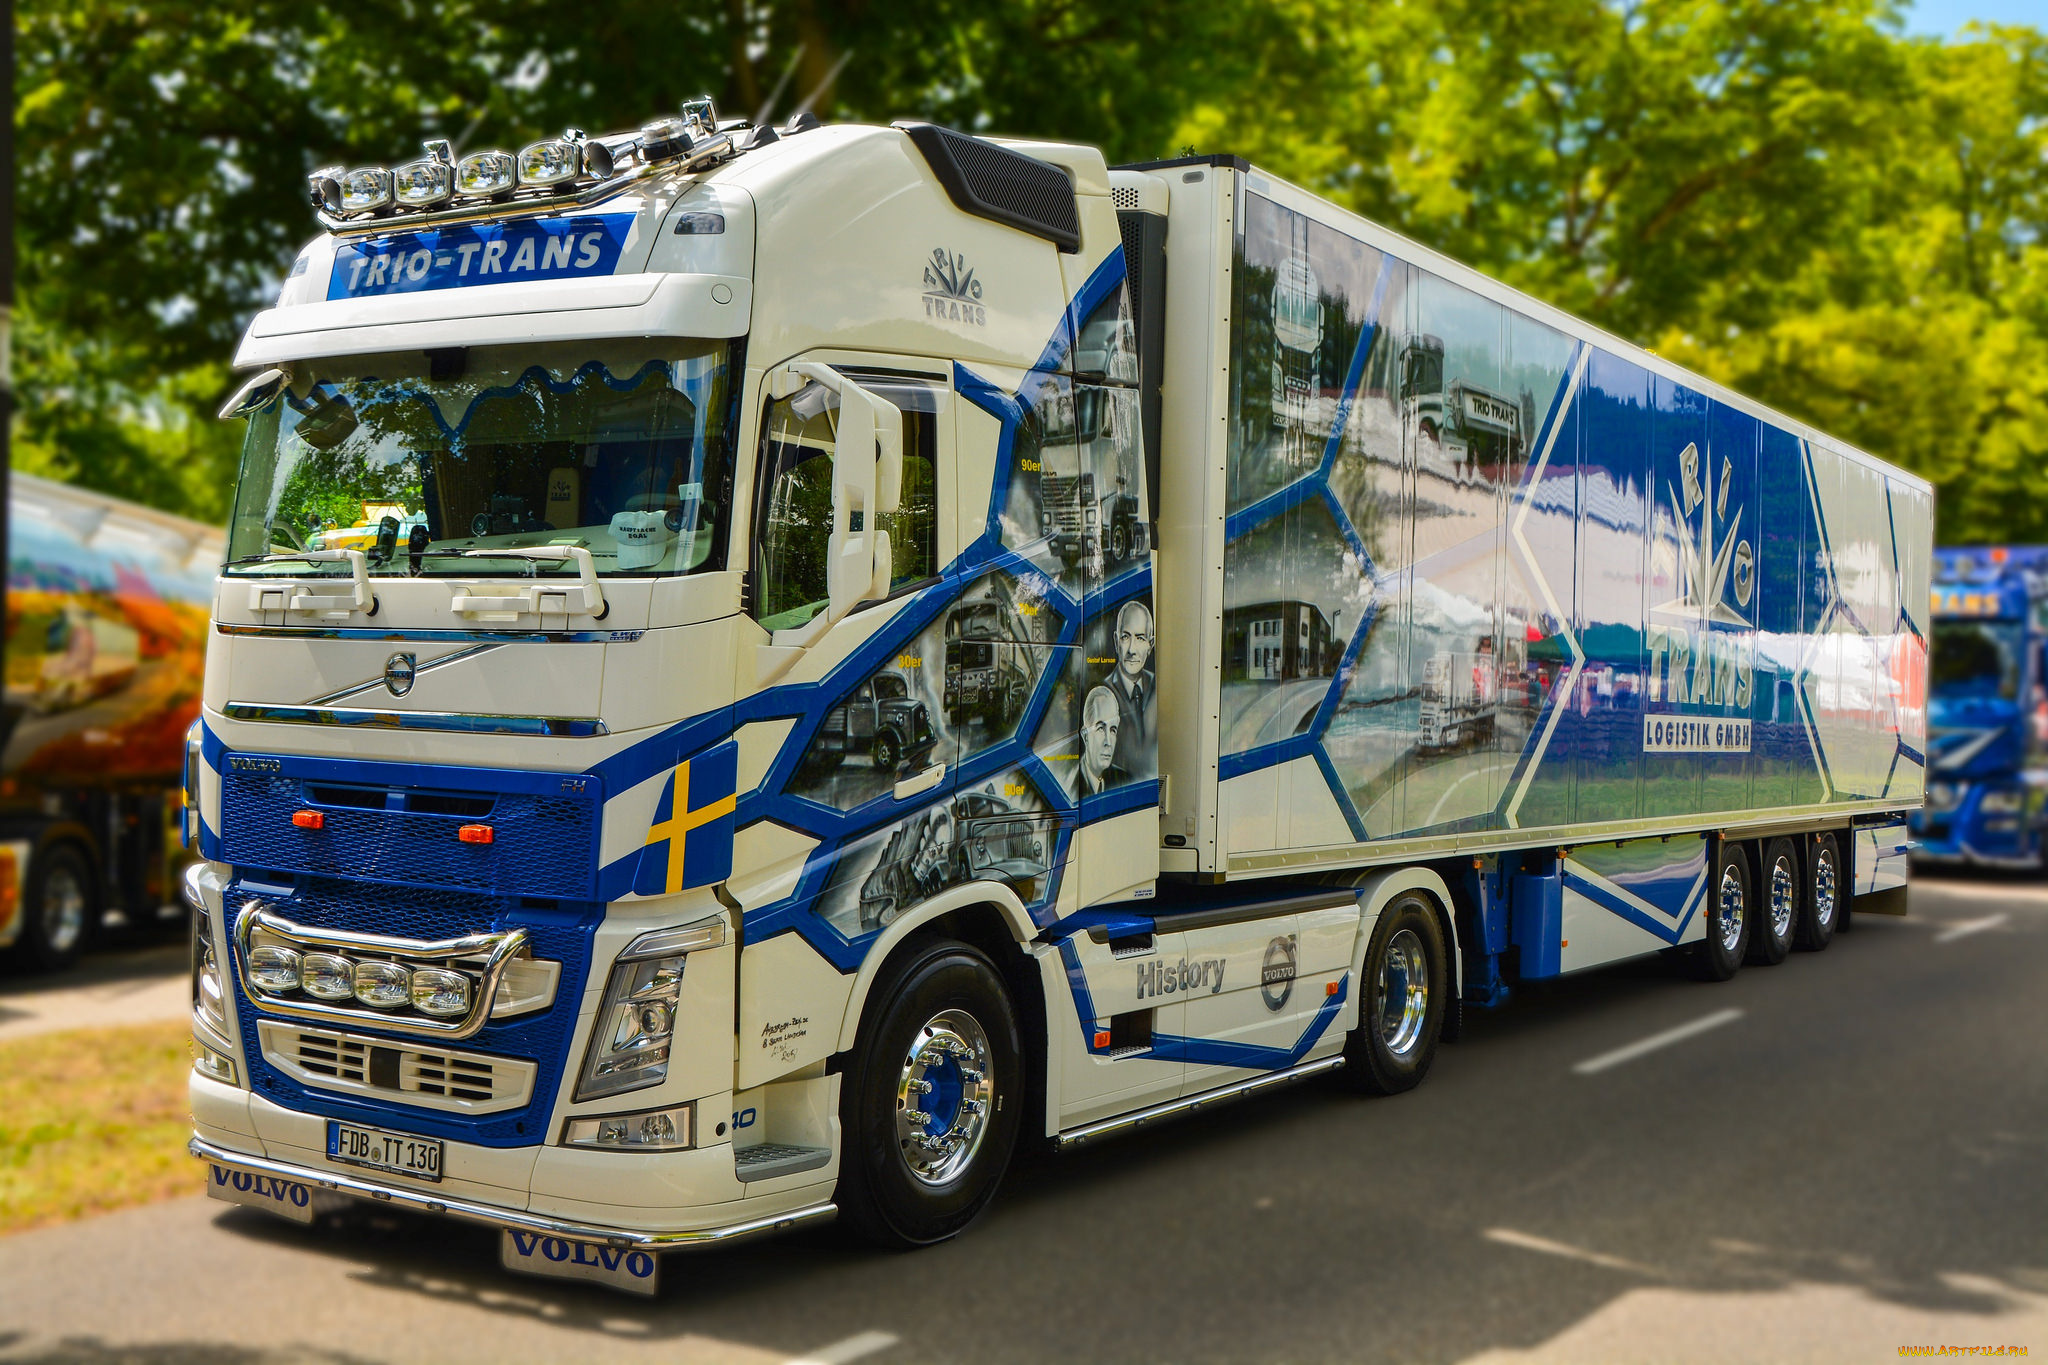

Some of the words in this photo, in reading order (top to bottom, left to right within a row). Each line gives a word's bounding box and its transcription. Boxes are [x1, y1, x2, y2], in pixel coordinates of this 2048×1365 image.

[348, 232, 603, 290] TRIO-TRANS
[922, 247, 983, 299] TRIO
[921, 296, 986, 327] TRANS
[1472, 397, 1490, 416] TRIO
[1021, 458, 1041, 472] 90er
[898, 655, 922, 669] 30er
[1645, 624, 1752, 709] TRANS
[1646, 721, 1710, 746] LOGISTIK
[1716, 723, 1750, 747] GMBH
[228, 757, 280, 772] VOLVO
[561, 778, 586, 793] FH
[1137, 957, 1226, 999] History
[1263, 966, 1294, 981] VOLVO
[339, 1128, 370, 1157] FDB
[383, 1136, 403, 1164] TT
[406, 1142, 438, 1171] 130
[213, 1165, 309, 1207] VOLVO
[508, 1230, 654, 1278] VOLVO
